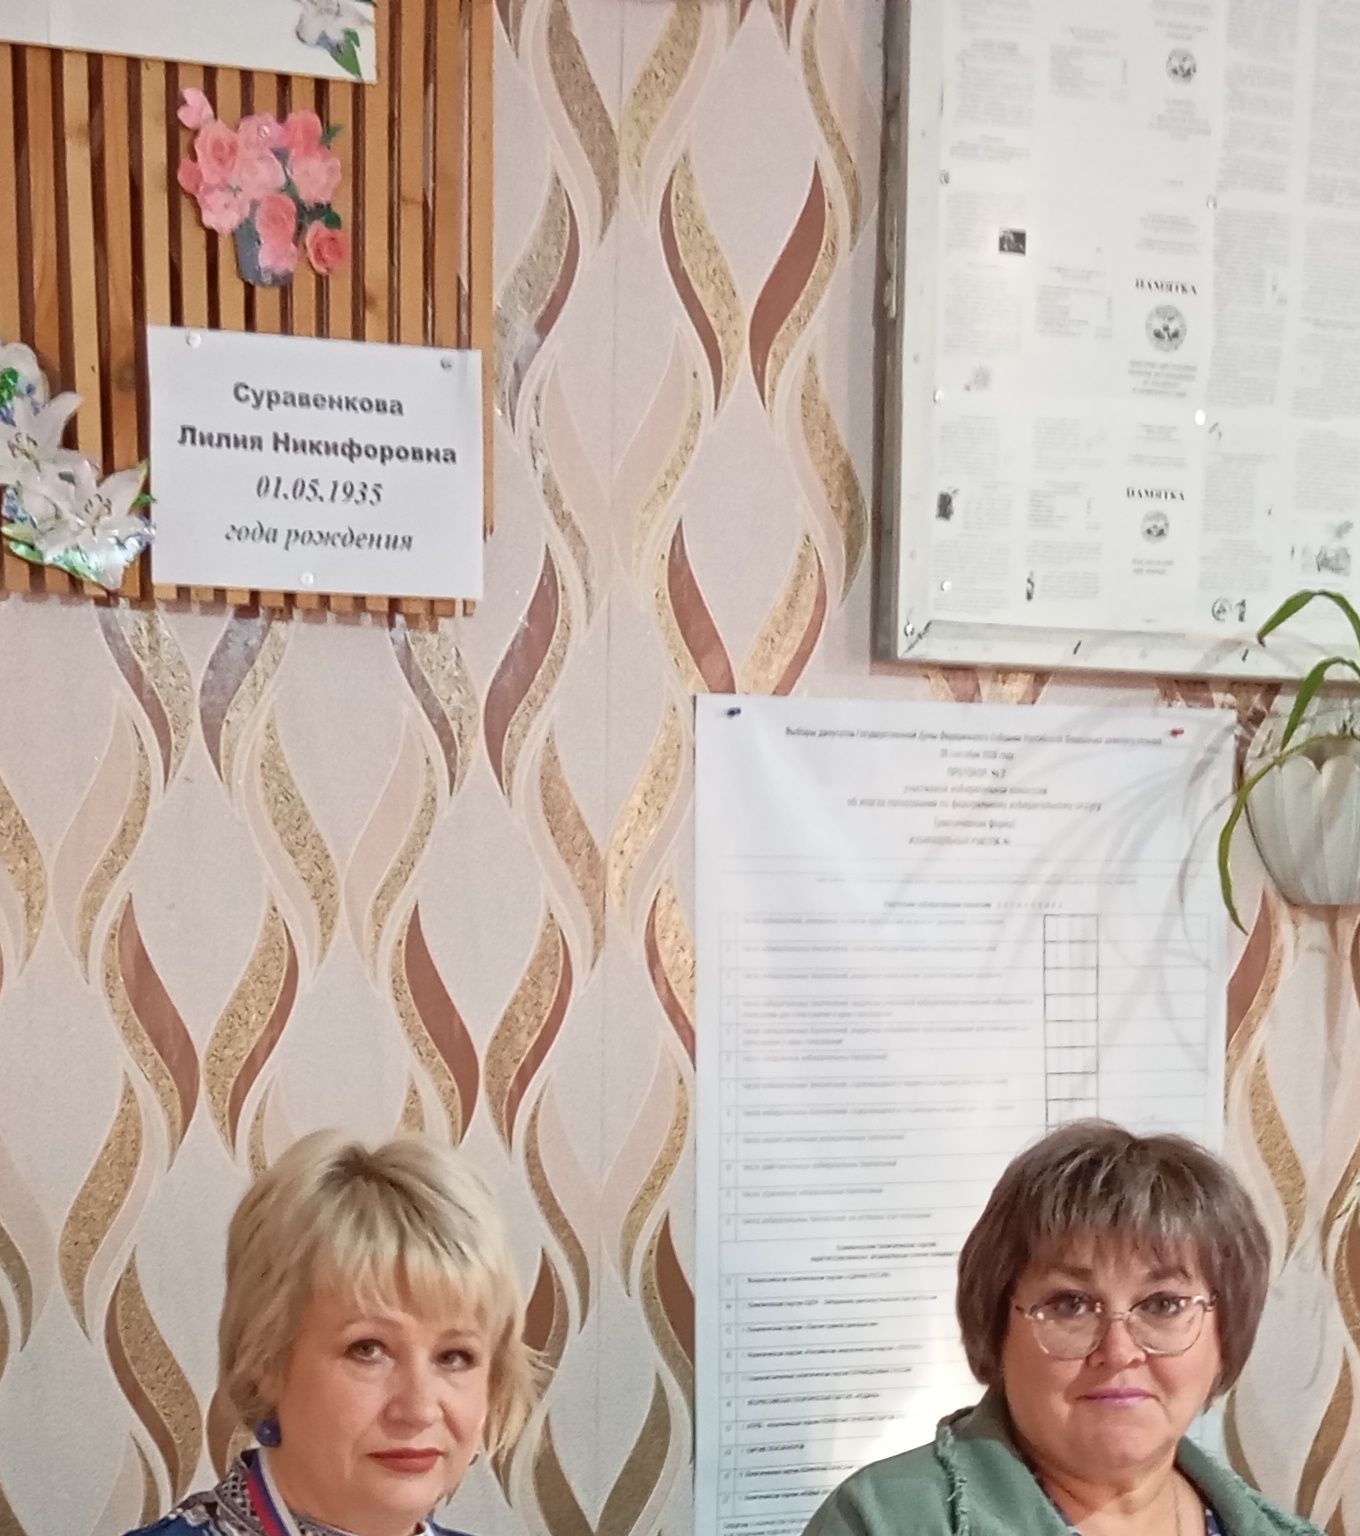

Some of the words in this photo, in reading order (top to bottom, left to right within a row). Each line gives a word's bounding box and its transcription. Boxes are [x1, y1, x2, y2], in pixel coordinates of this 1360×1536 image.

[232, 381, 404, 416] Суравенкова
[177, 425, 264, 452] Лилия
[272, 431, 457, 466] Никифоровна
[255, 475, 384, 507] 01.05.1935
[225, 522, 278, 548] года
[282, 526, 413, 555] рождения
